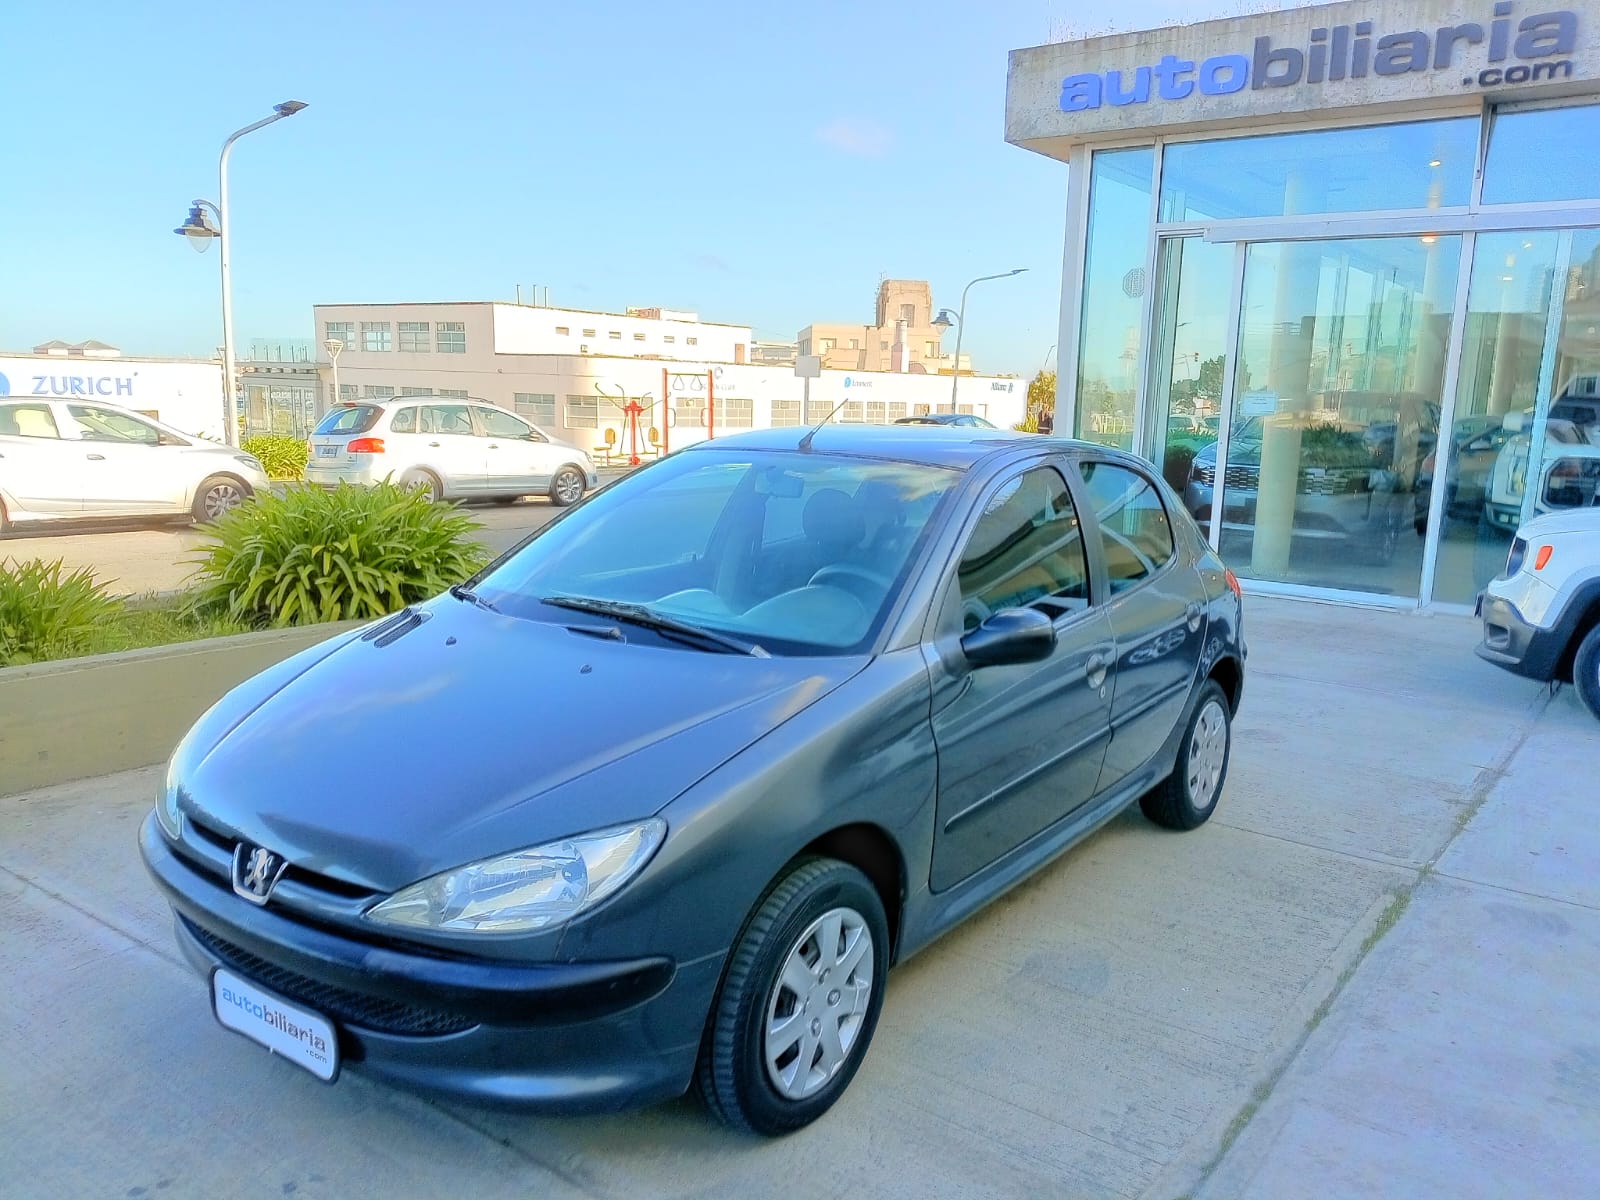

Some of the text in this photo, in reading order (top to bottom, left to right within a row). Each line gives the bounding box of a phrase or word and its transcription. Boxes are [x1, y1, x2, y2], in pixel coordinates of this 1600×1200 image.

[1059, 1, 1578, 112] autobiliaria
[1463, 60, 1573, 88] .com
[31, 375, 133, 396] ZURICH
[222, 987, 326, 1053] autobiliaria
[305, 1049, 328, 1064] .com
